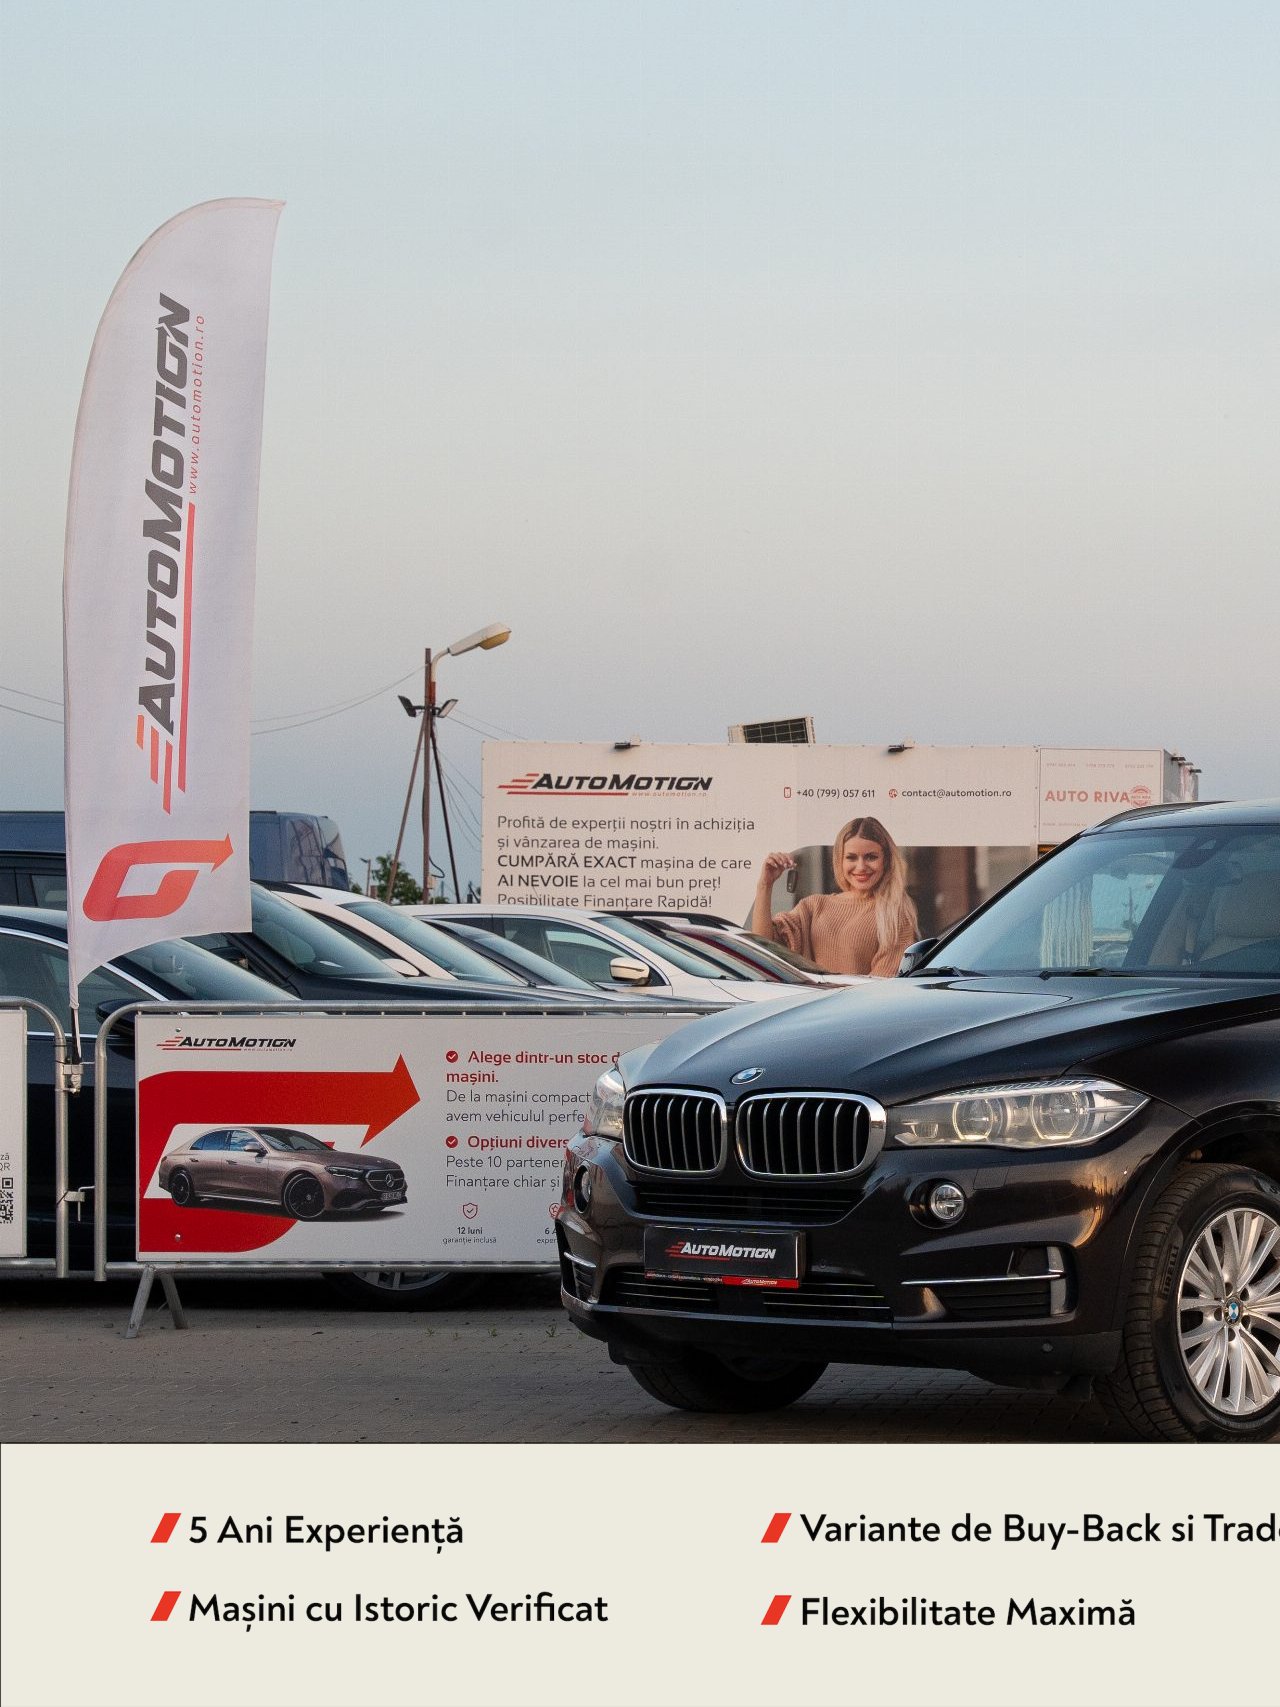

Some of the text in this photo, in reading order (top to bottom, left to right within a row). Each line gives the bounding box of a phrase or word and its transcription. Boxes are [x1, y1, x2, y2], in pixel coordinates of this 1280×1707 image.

[189, 315, 204, 494] www.automotion.ro
[797, 788, 874, 799] +40 (799) 057 611
[902, 789, 1011, 798] contact@automotion.ro
[1045, 790, 1088, 802] AUTO
[1094, 791, 1130, 803] RIVA
[498, 816, 754, 832] Profită de experții noștri în achiziția
[498, 836, 658, 852] și vânzarea de mașini.
[498, 853, 751, 871] CUMPĂRĂ EXACT mașina de care
[498, 874, 720, 891] AI NEVOIE la cel mai bun preț!
[498, 893, 711, 910] Posibilitate Finanțare Rapidă!
[468, 1051, 511, 1066] Alege
[516, 1051, 573, 1063] dintr-un
[578, 1054, 607, 1063] stoc
[447, 1070, 498, 1085] mașini.
[447, 1090, 466, 1102] De
[470, 1090, 480, 1102] la
[486, 1091, 527, 1106] mașini
[446, 1113, 481, 1121] avem
[486, 1109, 544, 1122] vehiculul
[468, 1136, 522, 1151] Opțiuni
[447, 1155, 483, 1167] Peste
[488, 1156, 502, 1168] 10
[447, 1175, 560, 1191] Finanțare chiar și
[545, 1227, 550, 1235] 6
